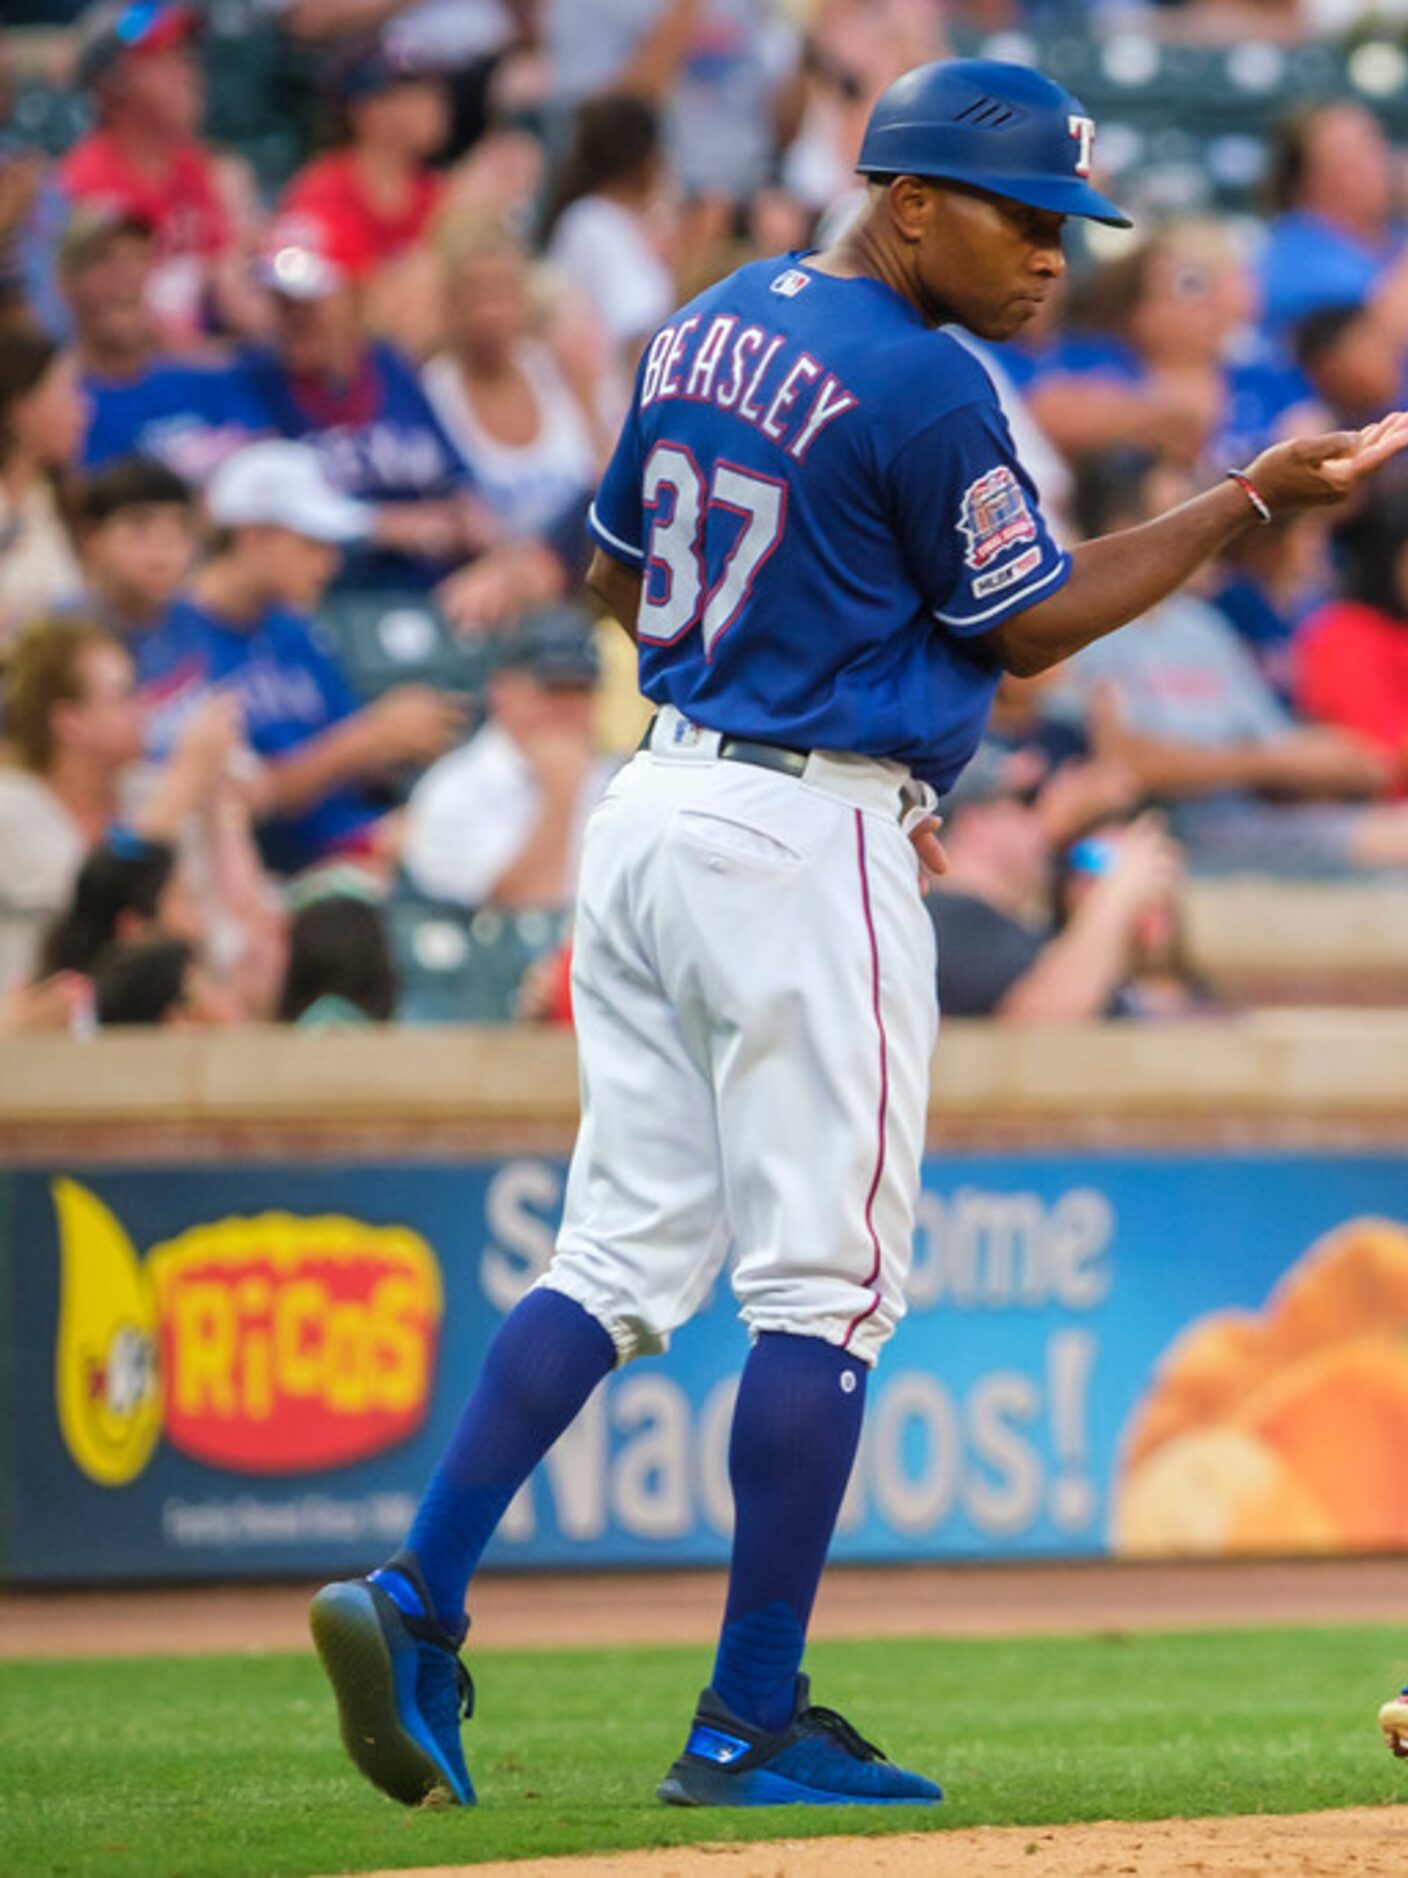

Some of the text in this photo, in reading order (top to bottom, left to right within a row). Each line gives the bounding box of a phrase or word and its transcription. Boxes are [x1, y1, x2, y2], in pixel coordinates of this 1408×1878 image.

[1068, 114, 1096, 178] T
[640, 313, 859, 466] BEASLEY
[637, 440, 788, 664] 37
